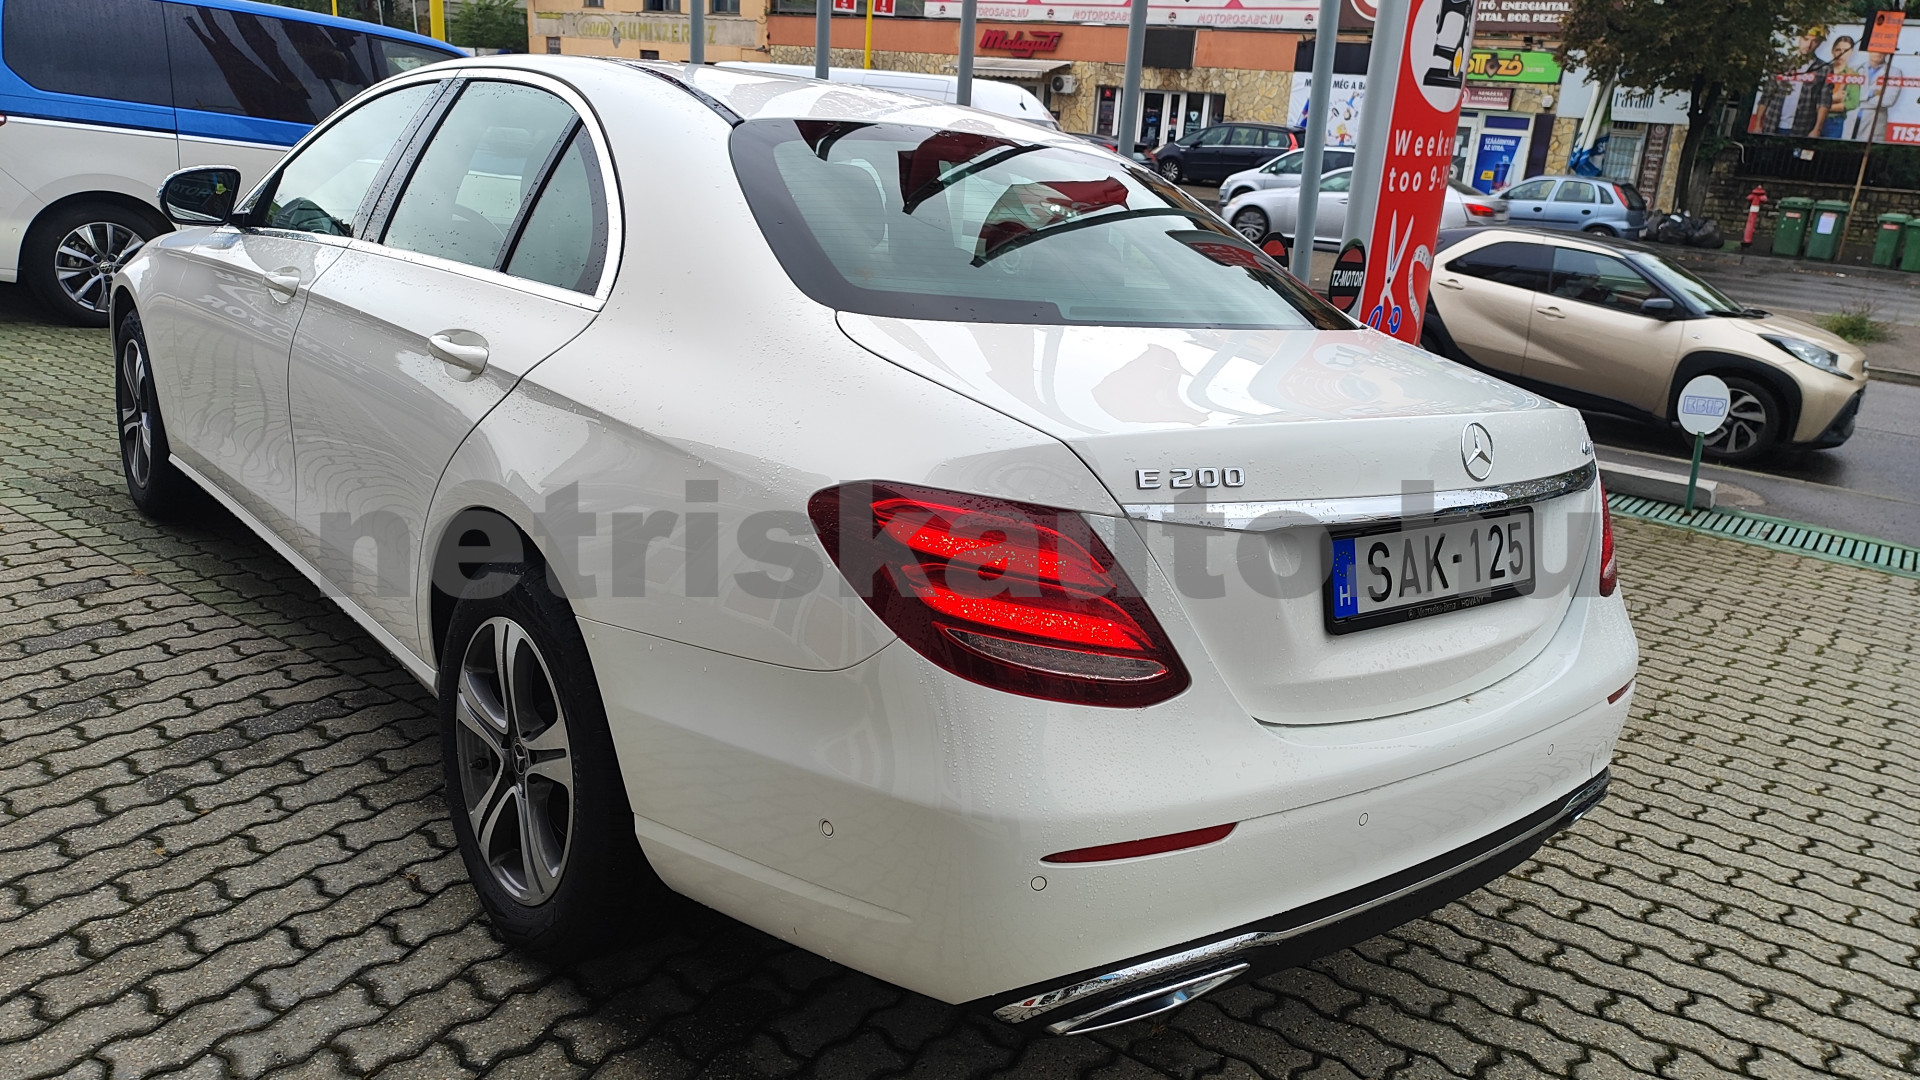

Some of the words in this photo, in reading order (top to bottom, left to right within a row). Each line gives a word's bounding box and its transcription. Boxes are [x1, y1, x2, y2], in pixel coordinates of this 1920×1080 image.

[976, 7, 1029, 18] TOROSABC.HU
[1072, 10, 1131, 21] MOTOROSAB
[582, 21, 610, 37] GOOD
[617, 21, 717, 44] GUMISZERZ
[979, 29, 1063, 58] Malaguti
[1389, 167, 1422, 192] too
[1331, 270, 1364, 287] TZ-MOTOR
[1135, 469, 1161, 490] E
[1169, 467, 1246, 490] 200
[1367, 522, 1524, 603] SAK-125
[1339, 585, 1351, 607] H
